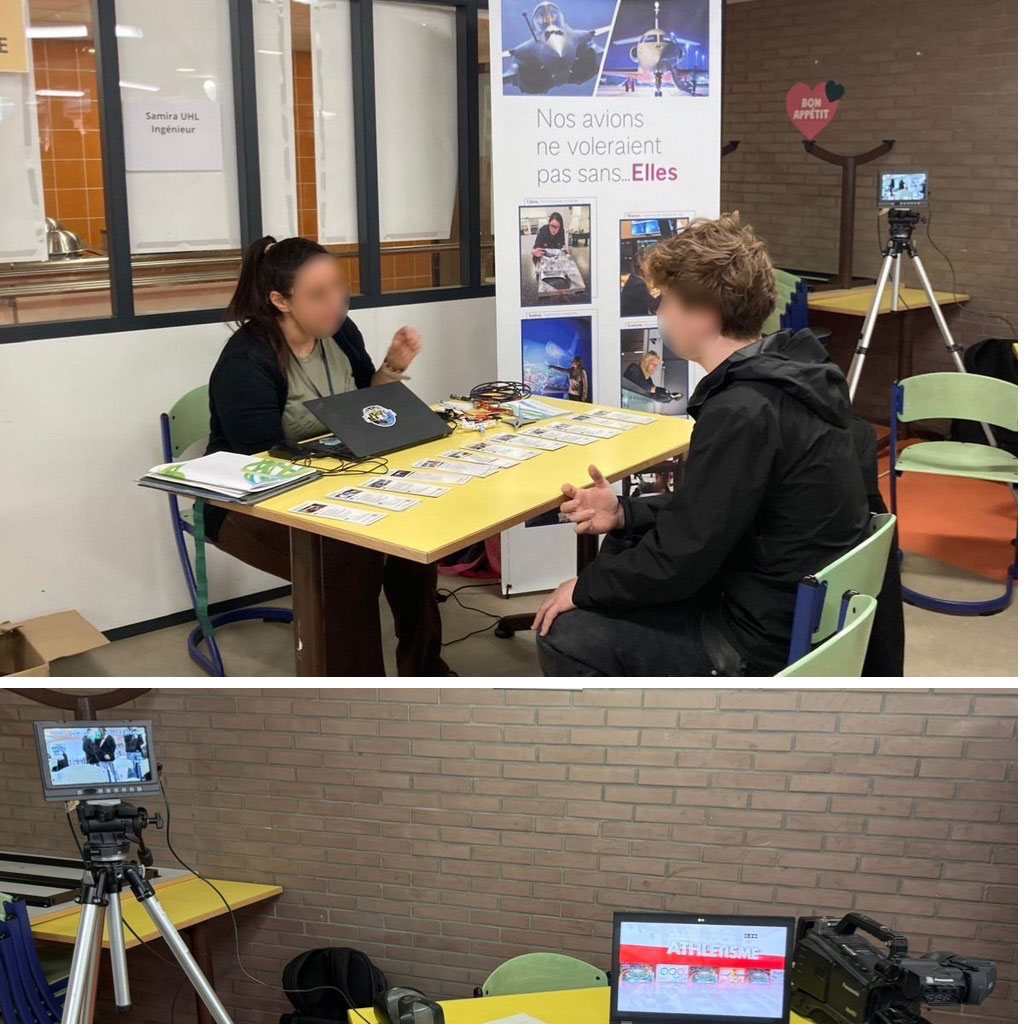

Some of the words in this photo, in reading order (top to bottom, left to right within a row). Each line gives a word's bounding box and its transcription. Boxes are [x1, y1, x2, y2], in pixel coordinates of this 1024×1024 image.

[801, 98, 822, 108] BON
[146, 112, 178, 121] Samira
[180, 112, 199, 121] UHL
[537, 109, 576, 129] Nos
[583, 108, 644, 128] avions
[793, 107, 829, 120] APPÉTIT
[151, 125, 195, 135] Ingénieur
[537, 139, 561, 157] ne
[568, 137, 662, 155] voleraient
[537, 167, 572, 188] pas
[667, 939, 760, 960] ATHLETISME
